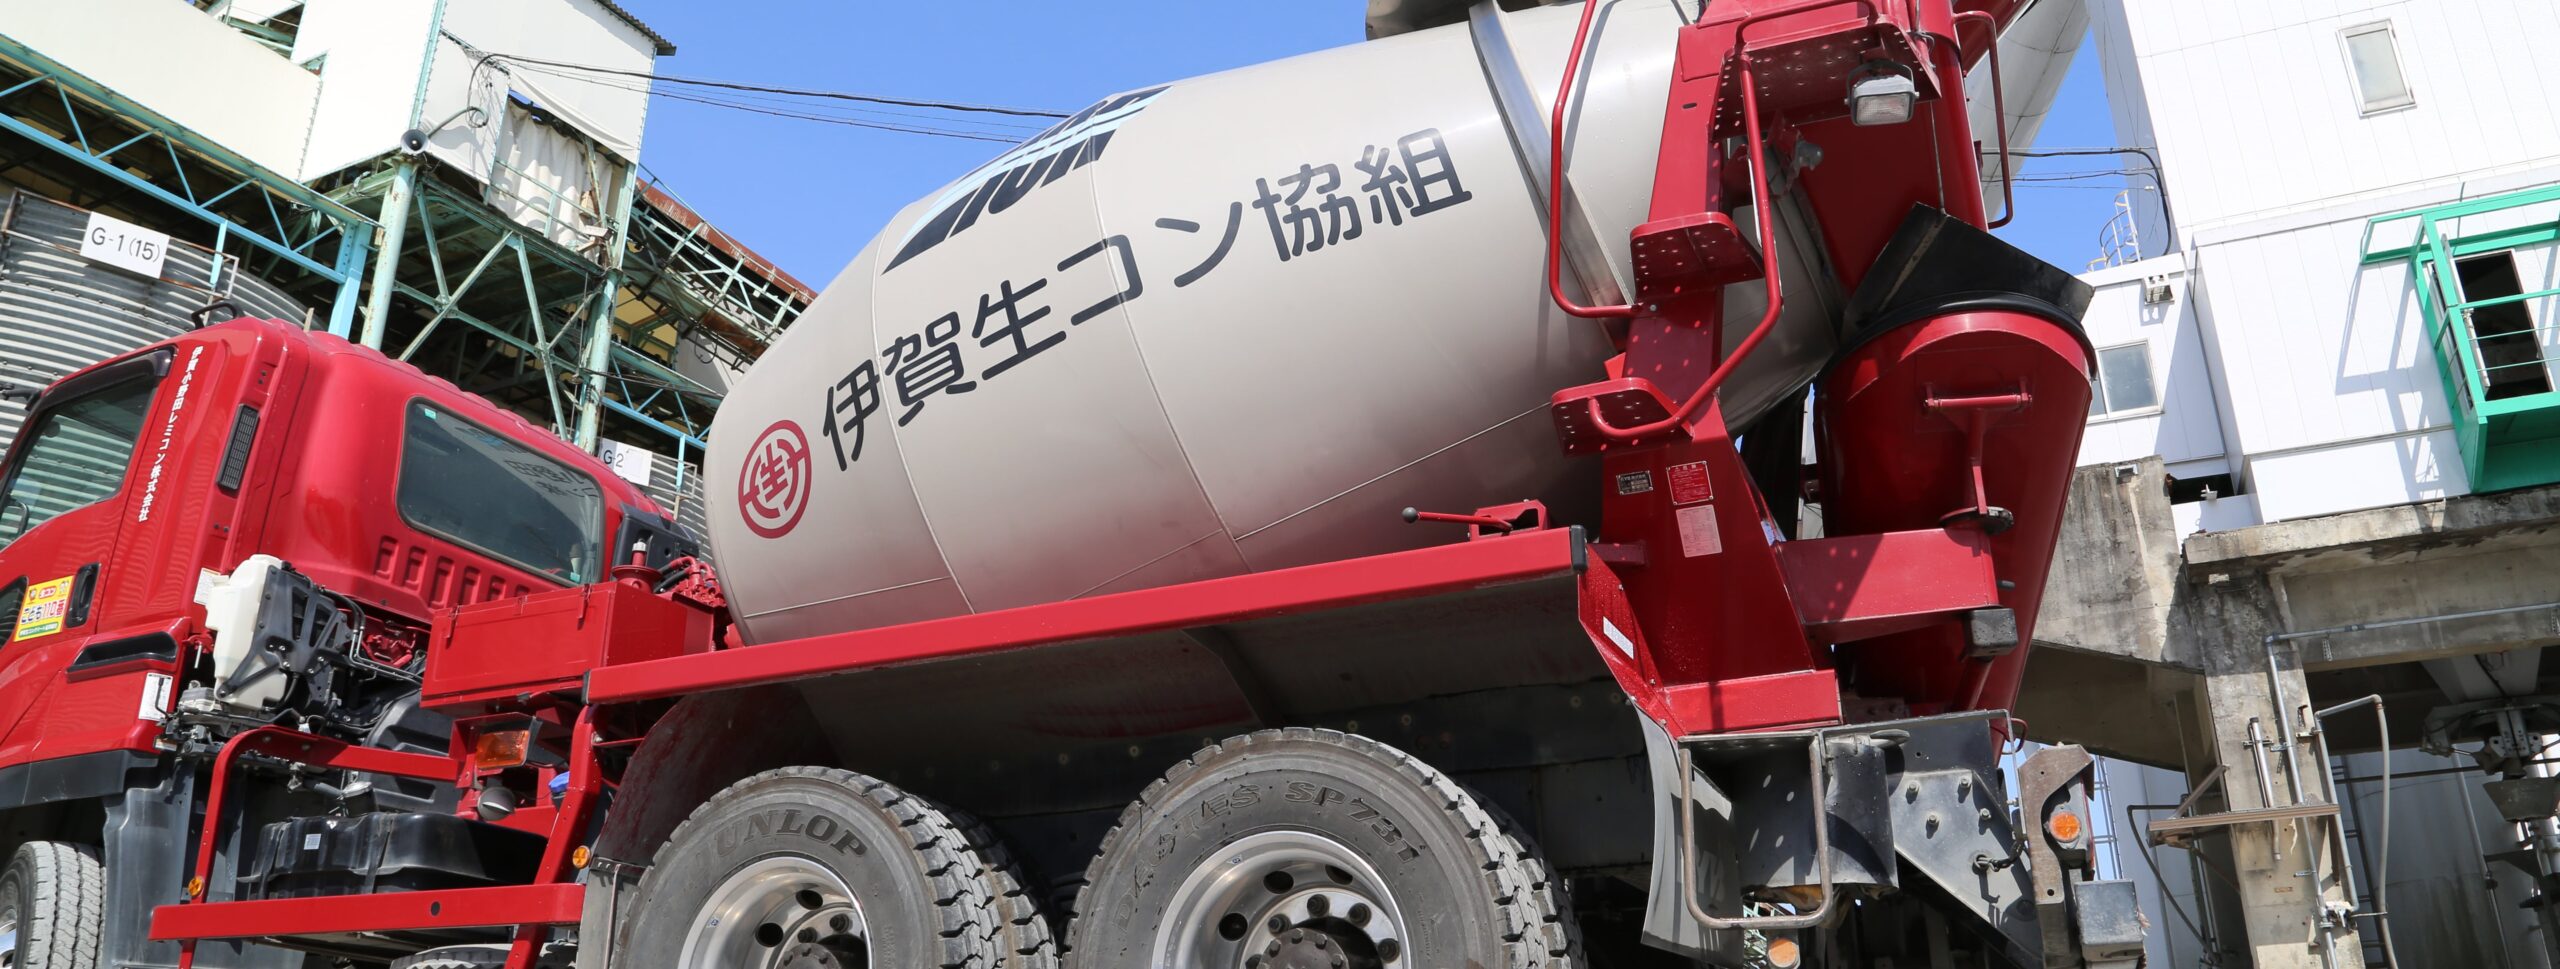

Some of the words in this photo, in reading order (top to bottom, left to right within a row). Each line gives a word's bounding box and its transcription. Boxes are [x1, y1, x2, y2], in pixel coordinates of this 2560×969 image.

[91, 226, 161, 263] G-1(15)
[822, 126, 1473, 473] 伊賀生コン協組
[138, 345, 204, 522] 伊賀小野田レミコン株式会社
[698, 808, 869, 868] UNLOP
